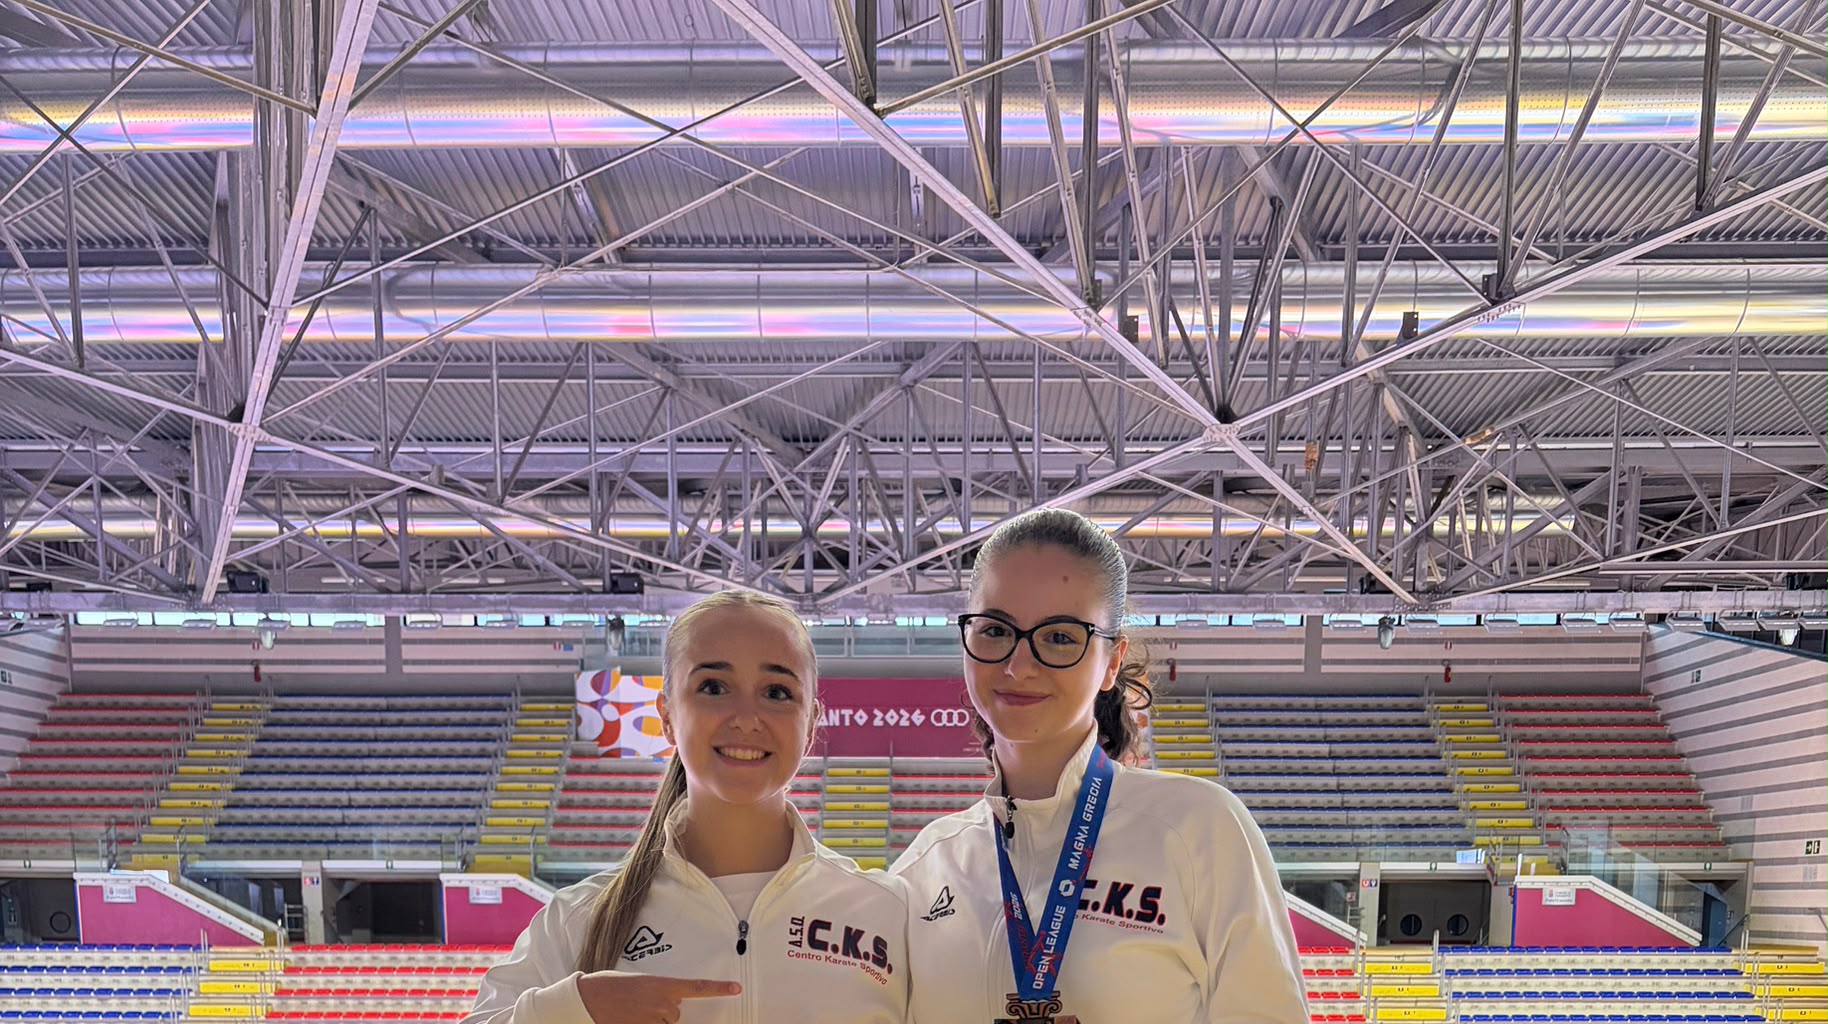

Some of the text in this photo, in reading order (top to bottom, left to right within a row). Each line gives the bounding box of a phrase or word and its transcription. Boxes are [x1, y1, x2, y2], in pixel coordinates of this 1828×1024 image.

[873, 709, 925, 726] 2026
[1068, 777, 1102, 870] MAGNA GRECIA
[1082, 913, 1115, 926] Karate
[1118, 921, 1164, 934] Sportivo
[787, 949, 888, 985] Centro Karate Sportivo
[807, 919, 893, 975] C.K.S.
[1032, 905, 1066, 990] OPEN LEAGUE
